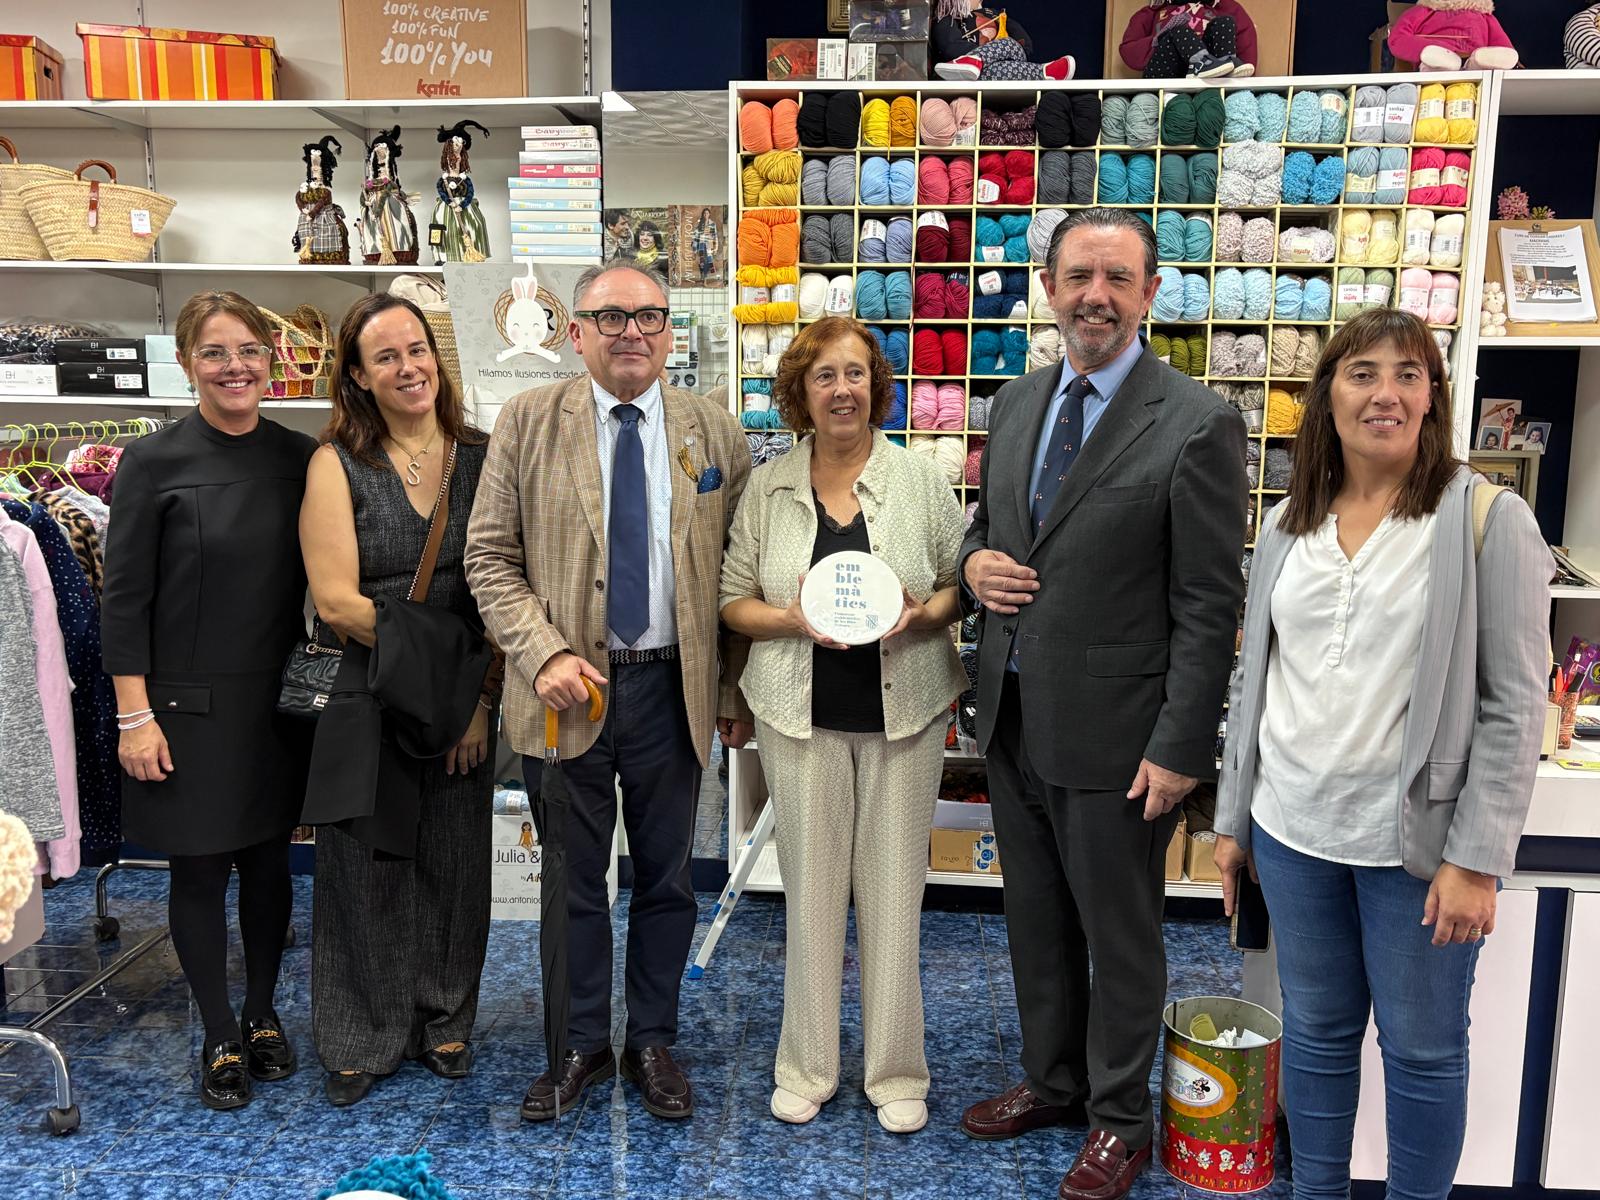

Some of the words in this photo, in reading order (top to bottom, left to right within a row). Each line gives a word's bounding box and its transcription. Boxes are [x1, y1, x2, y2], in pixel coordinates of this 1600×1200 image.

[383, 0, 419, 20] 100%
[424, 6, 489, 24] CREATIVE
[392, 19, 427, 39] 100%
[430, 22, 461, 39] FUN
[380, 37, 448, 75] 100%
[416, 79, 461, 98] katia
[478, 369, 512, 378] Hilamos
[515, 369, 551, 379] ilusiones
[835, 572, 862, 584] ble
[495, 849, 526, 864] Julia
[530, 850, 541, 864] &
